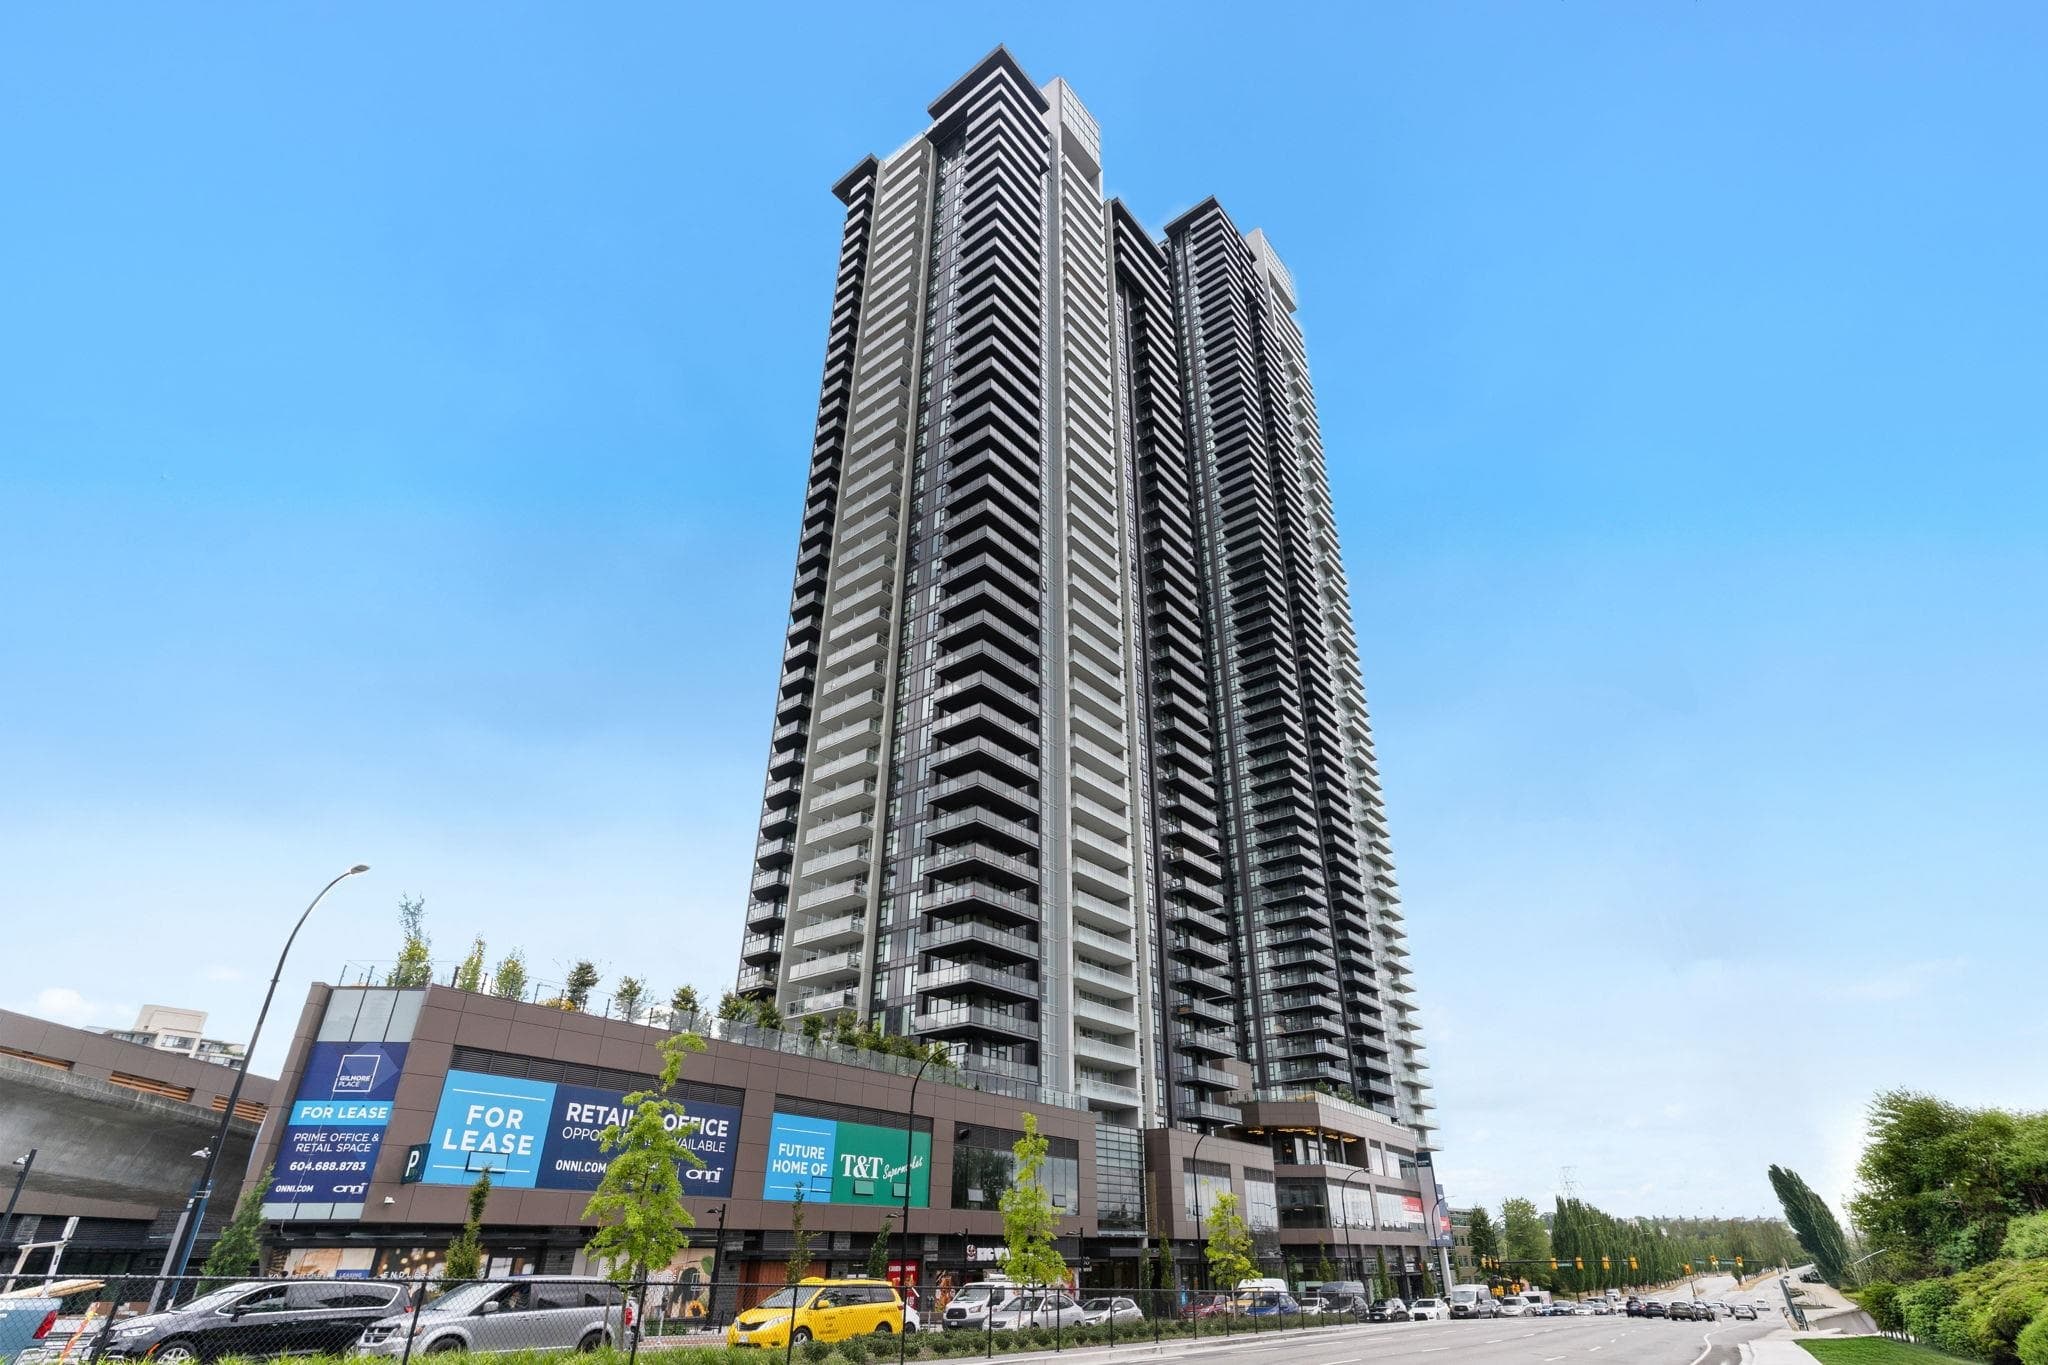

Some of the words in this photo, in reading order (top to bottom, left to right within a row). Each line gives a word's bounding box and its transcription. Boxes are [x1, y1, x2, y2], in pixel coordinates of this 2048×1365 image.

[301, 1106, 333, 1119] FOR
[338, 1106, 389, 1119] LEASE
[466, 1104, 524, 1130] FOR
[293, 1133, 328, 1142] PRIME
[330, 1133, 371, 1142] OFFICE
[371, 1133, 380, 1142] &
[442, 1128, 535, 1156] LEASE
[674, 1136, 727, 1153] VAILABLE
[295, 1143, 333, 1152] RETAIL
[335, 1143, 371, 1152] SPACE
[778, 1143, 826, 1160] FUTURE
[289, 1161, 367, 1171] 604.688.8783
[405, 1150, 420, 1177] P
[555, 1159, 608, 1173] ONNI.COM
[772, 1159, 808, 1175] HOME
[810, 1163, 828, 1176] OF
[840, 1153, 883, 1180] T&T
[686, 1167, 724, 1181] onni
[275, 1184, 314, 1193] ONNI.COM
